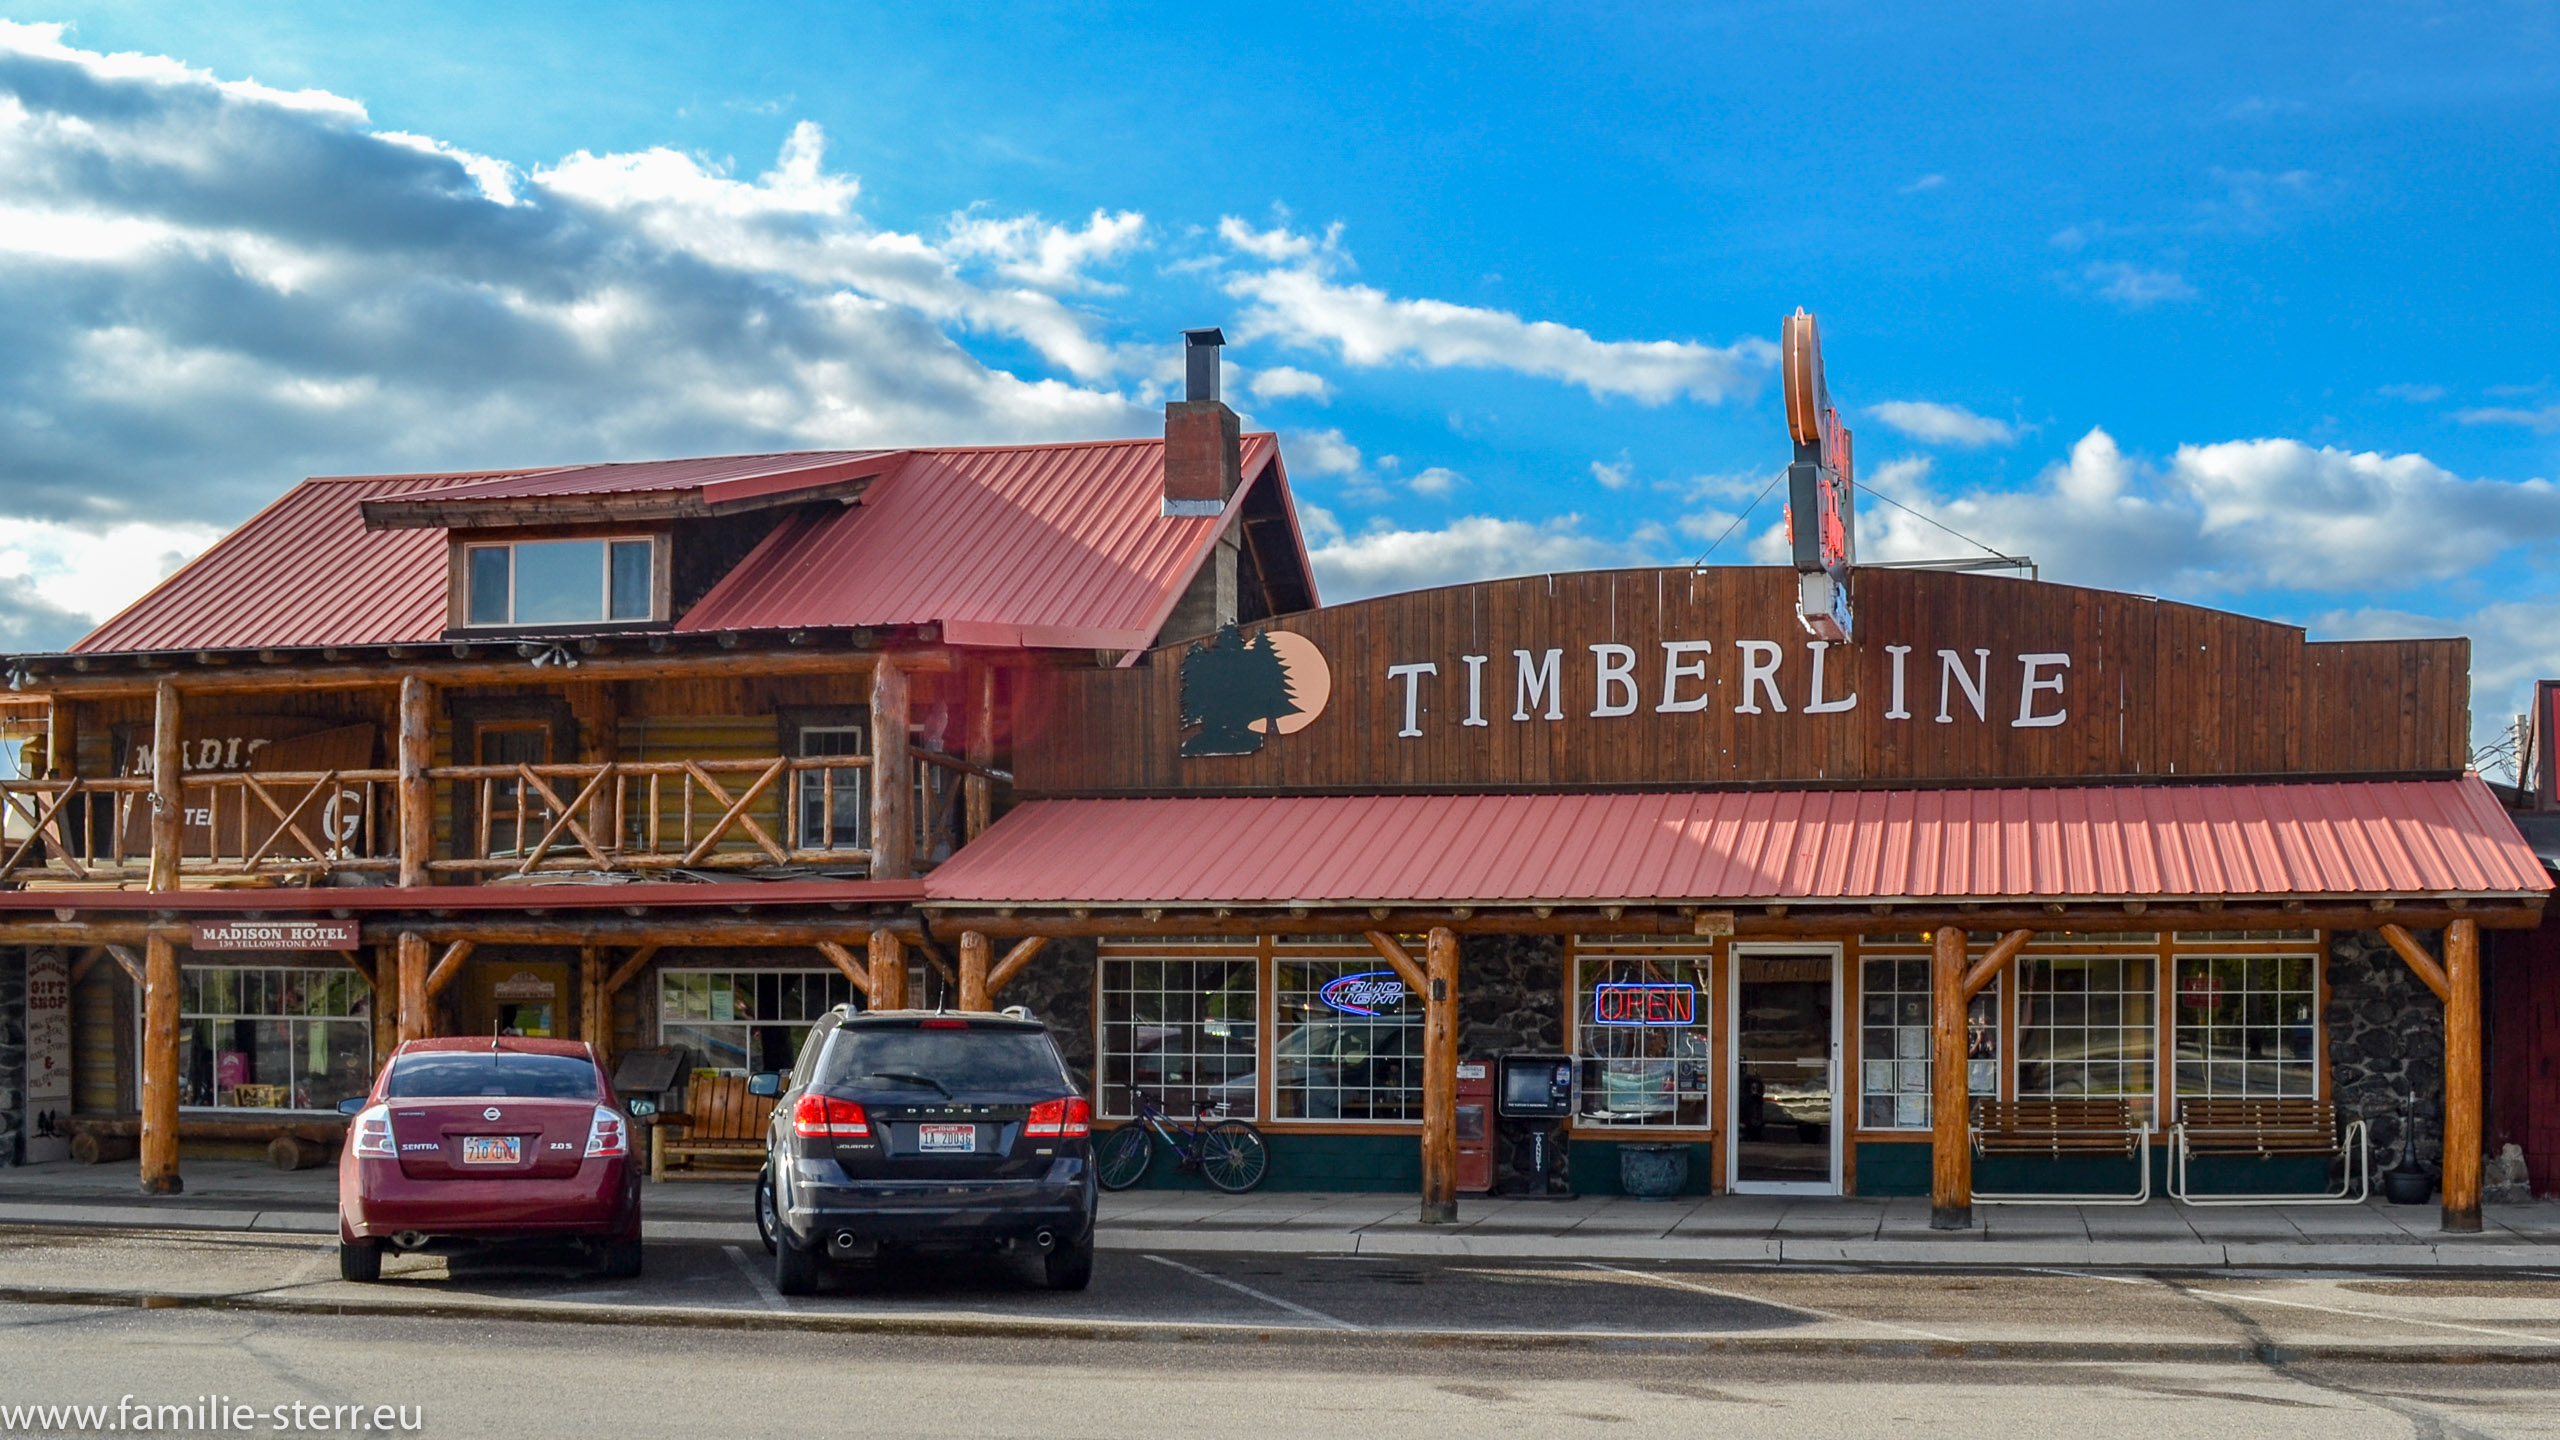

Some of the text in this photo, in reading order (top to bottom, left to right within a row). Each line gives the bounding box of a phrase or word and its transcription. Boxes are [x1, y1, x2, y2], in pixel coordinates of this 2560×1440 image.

[1387, 639, 2071, 738] TIMBERLINE
[203, 927, 347, 940] MADISON HOTEL
[219, 940, 332, 948] 139 YELLOWSTONE AVE.
[31, 981, 66, 994] GIFT
[1344, 980, 1402, 993] BUD
[31, 996, 67, 1010] SHOP
[1331, 992, 1404, 1005] LIGHT
[1600, 987, 1691, 1020] OPEN
[402, 1143, 439, 1151] SENTRA
